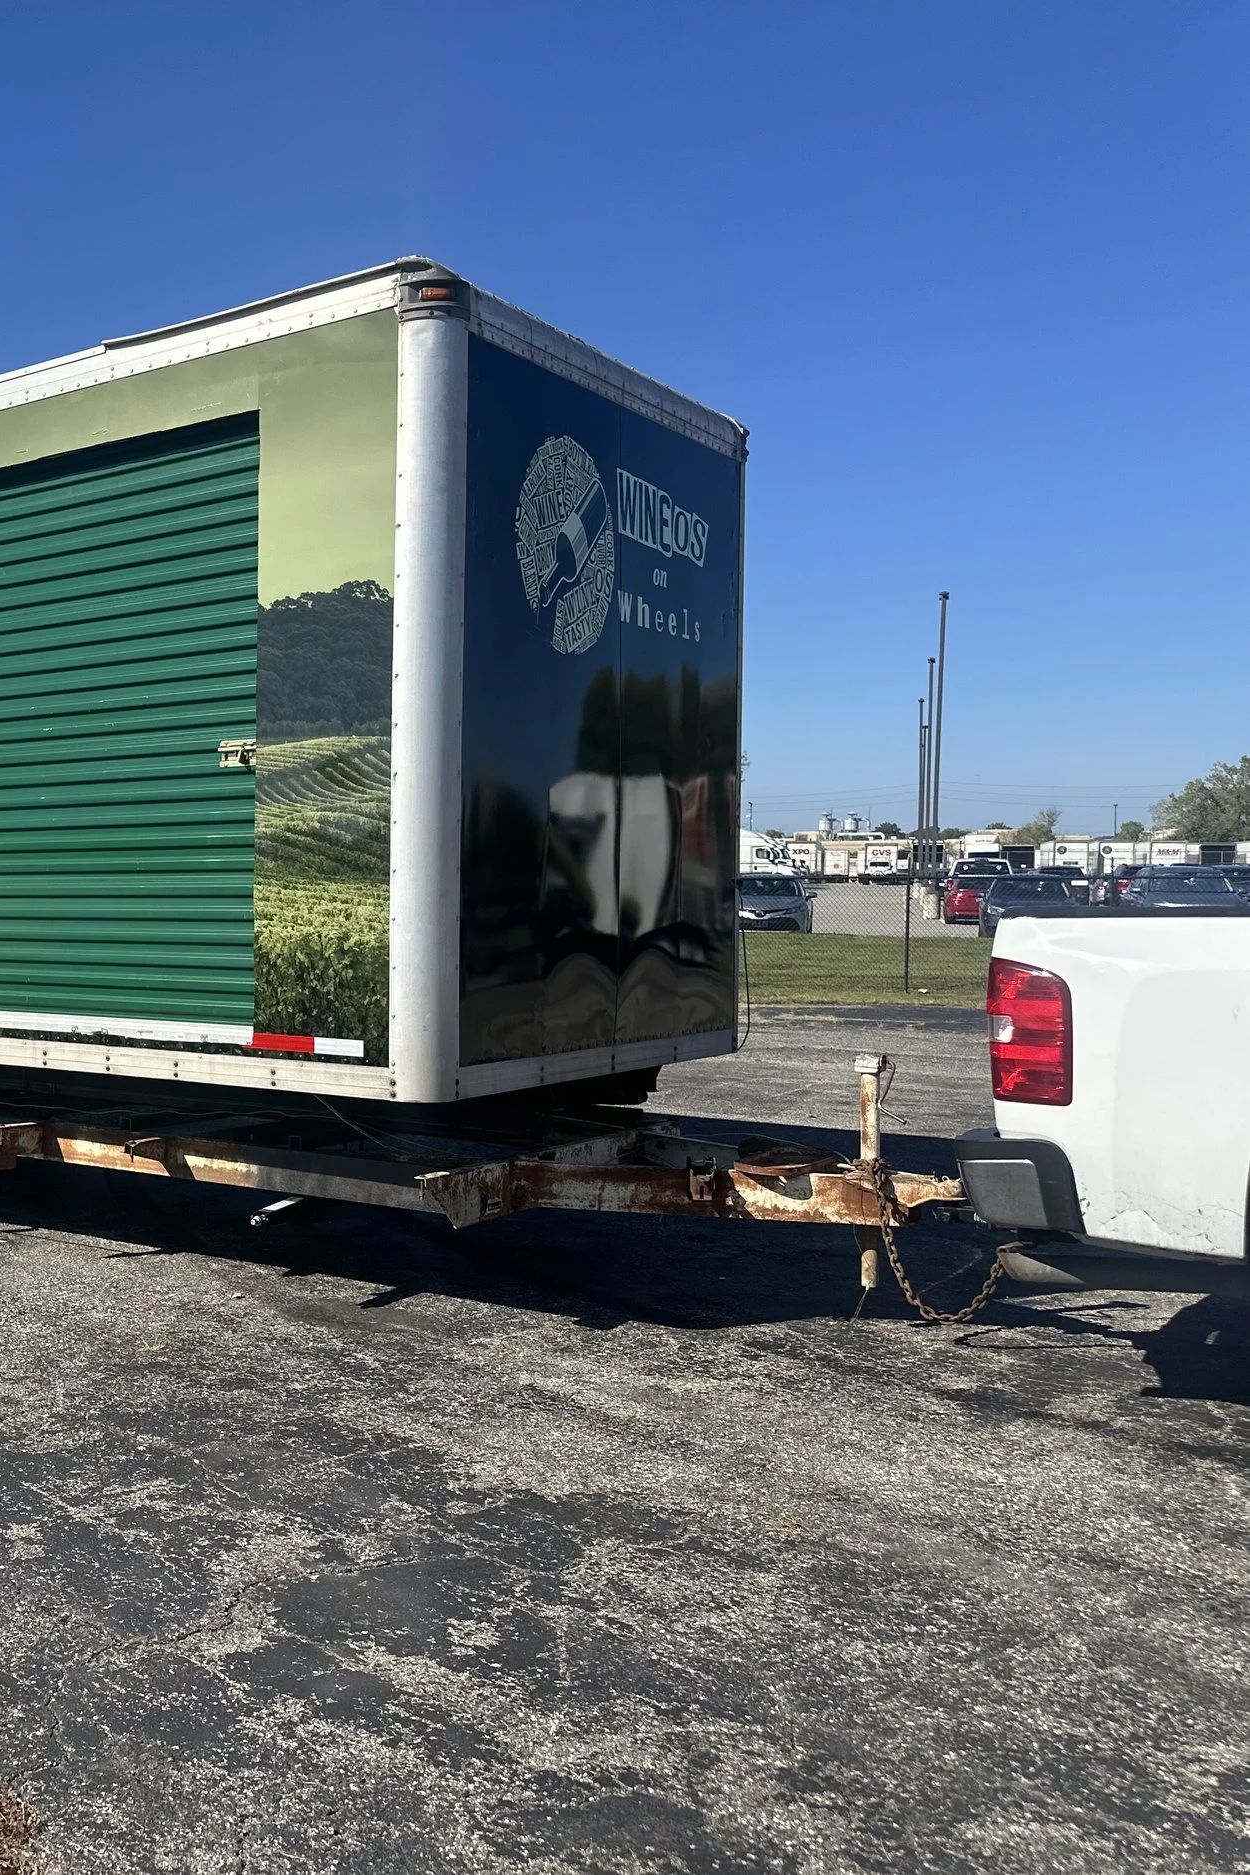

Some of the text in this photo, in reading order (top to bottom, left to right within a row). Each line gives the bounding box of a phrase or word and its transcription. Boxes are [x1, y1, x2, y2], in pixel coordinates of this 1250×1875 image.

[553, 457, 563, 487] CORK
[534, 490, 565, 527] WINE
[618, 471, 706, 563] WINEOS
[523, 559, 538, 598] BLEND
[653, 567, 668, 588] on
[565, 616, 591, 648] TASTY
[871, 848, 892, 857] CVS
